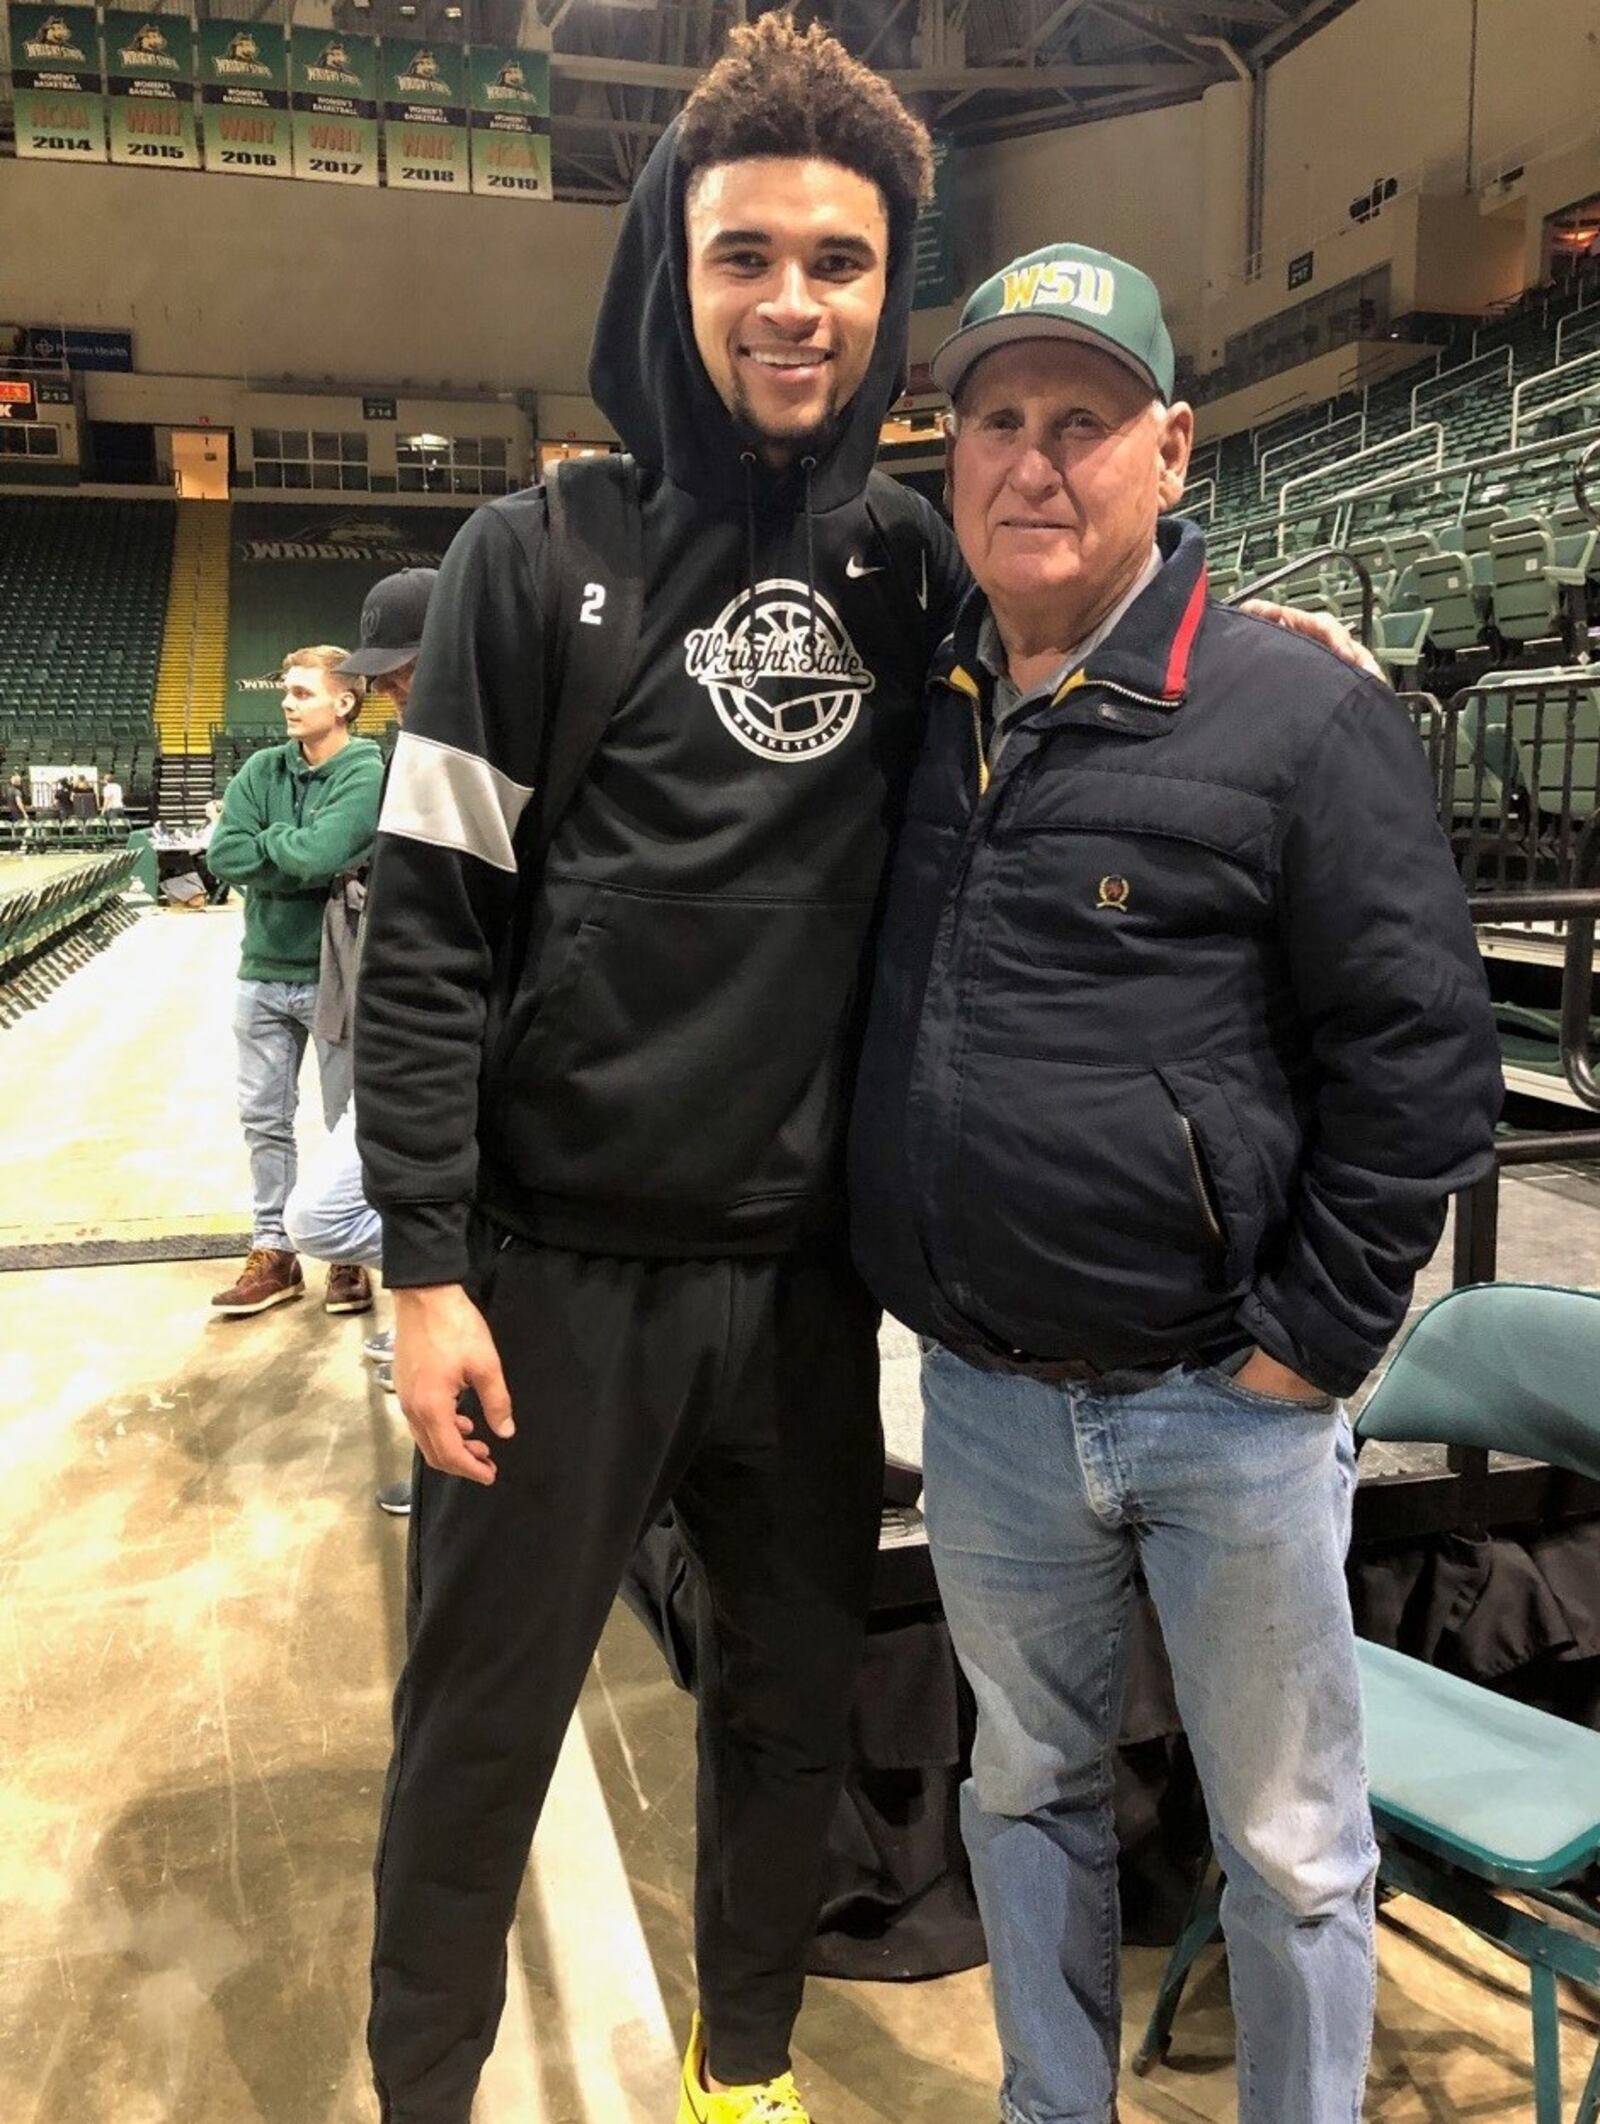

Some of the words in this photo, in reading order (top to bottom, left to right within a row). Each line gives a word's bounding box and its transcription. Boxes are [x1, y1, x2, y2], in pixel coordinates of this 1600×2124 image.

[38, 72, 77, 82] WOMEN'S
[33, 80, 83, 91] BASKETBALL
[134, 80, 171, 91] WOMEN'S
[129, 88, 177, 98] BASKETBALL
[227, 89, 264, 99] WOMEN'S
[222, 95, 270, 107] BASKETBALL
[317, 97, 353, 108] WOMEN'S
[312, 103, 358, 116] BASKETBALL
[408, 105, 444, 115] WOMEN'S
[404, 112, 449, 124] BASKETBALL
[494, 113, 528, 124] WOMEN'S
[489, 121, 532, 133] BASKETBALL
[32, 135, 93, 152] 2014
[127, 143, 184, 160] 2015
[220, 151, 277, 167] 2016
[308, 158, 364, 176] 2017
[402, 167, 455, 183] 2018
[487, 174, 539, 191] 2019
[998, 260, 1114, 316] WSU
[251, 541, 373, 560] WRIGHT
[580, 582, 606, 625] 2
[685, 629, 793, 688] Wright
[799, 630, 873, 677] State
[732, 712, 849, 751] BASKETBALL
